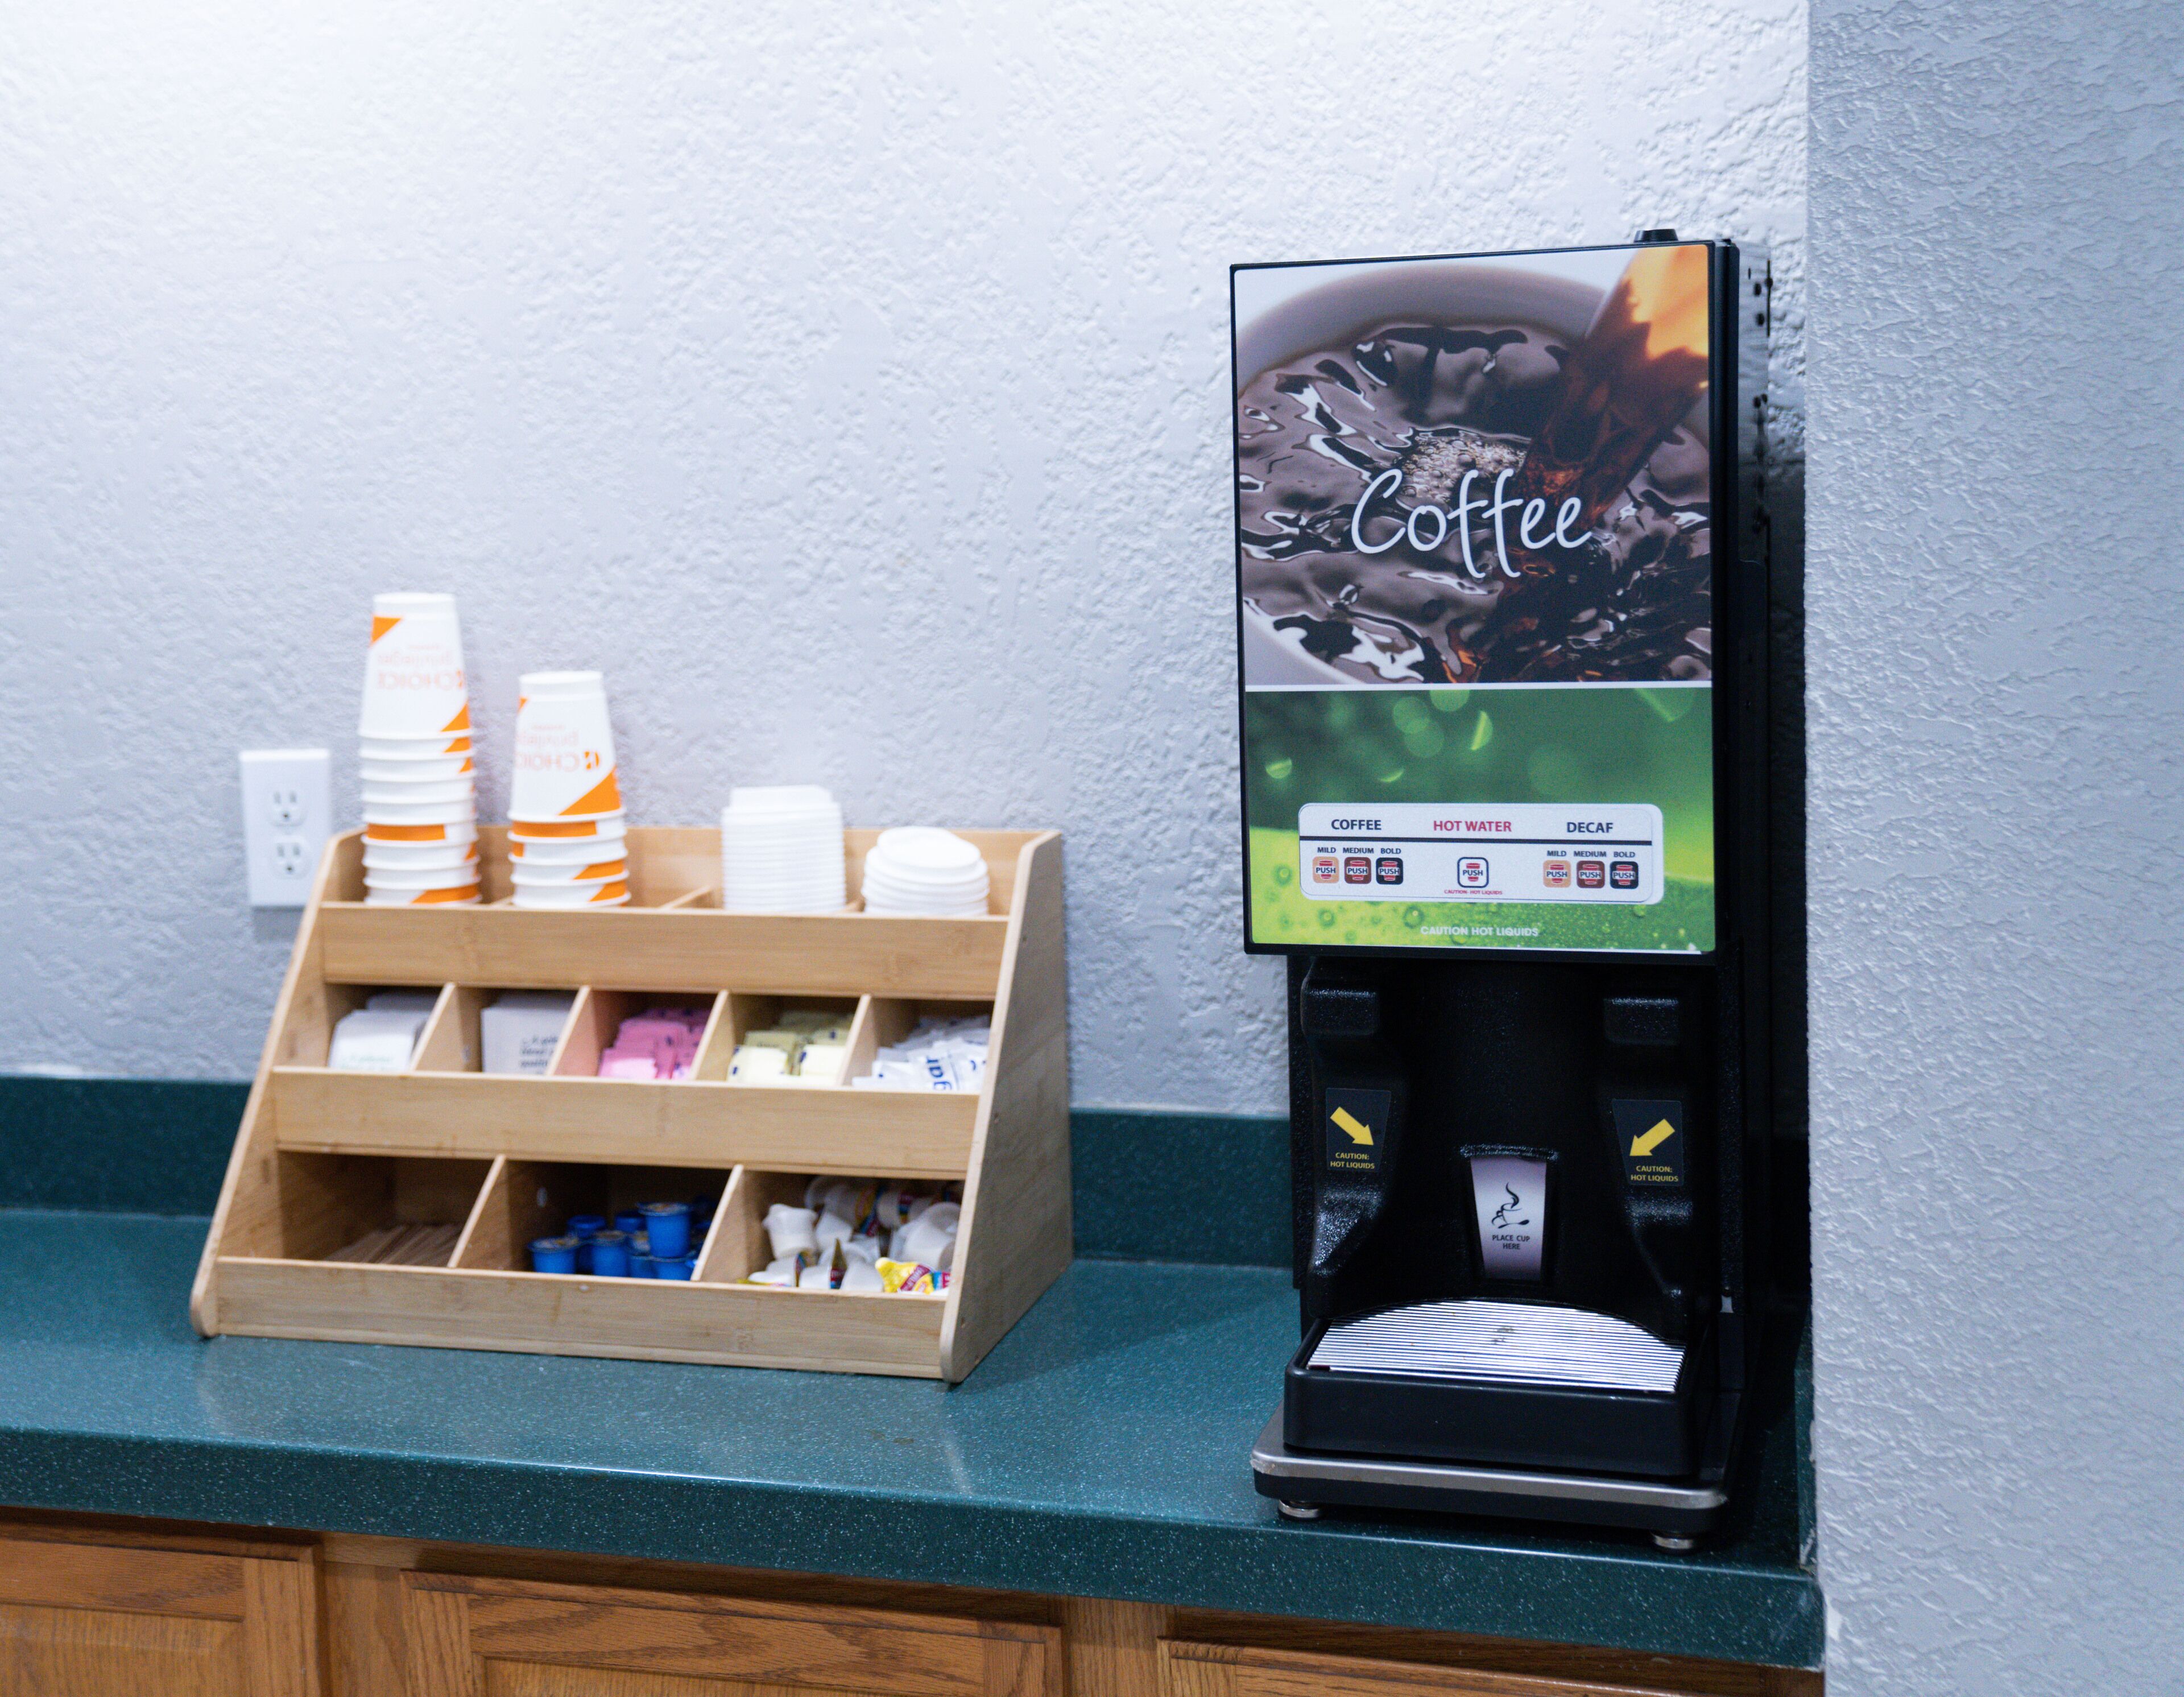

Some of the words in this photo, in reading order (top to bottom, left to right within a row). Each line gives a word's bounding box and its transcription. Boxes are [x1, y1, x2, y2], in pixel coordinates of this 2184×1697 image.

[1351, 468, 1592, 578] Coffee
[1331, 819, 1381, 830] COFFEE
[1434, 820, 1462, 831] HOT
[1465, 821, 1512, 832] WATER
[1567, 822, 1613, 833] DECAF
[1421, 926, 1468, 935] CAUTION
[1471, 927, 1494, 936] HOT
[1496, 927, 1538, 936] LIQUIDS
